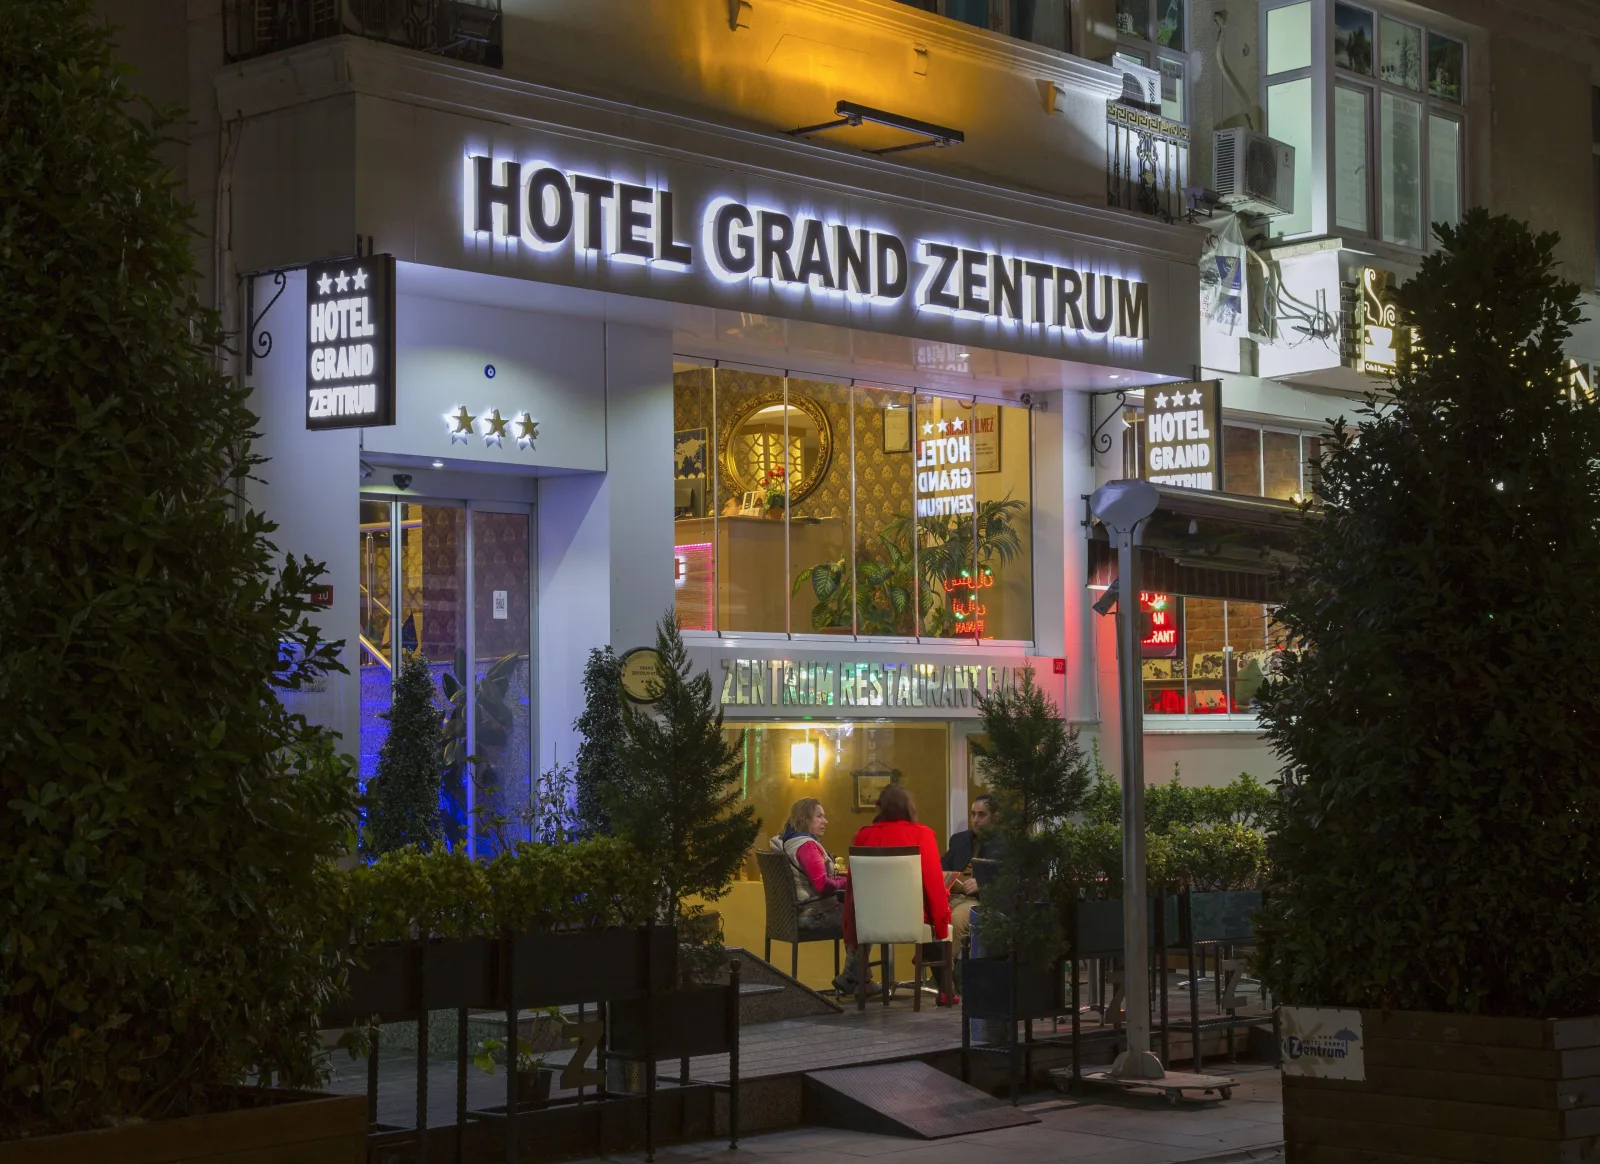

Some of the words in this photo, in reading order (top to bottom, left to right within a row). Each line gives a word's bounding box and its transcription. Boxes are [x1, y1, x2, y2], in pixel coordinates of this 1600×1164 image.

[471, 156, 692, 265] HOTEL
[712, 203, 908, 299] GRAND
[922, 243, 1149, 340] ZENTRUM
[310, 297, 374, 342] HOTEL
[311, 344, 373, 380] GRAND
[309, 384, 376, 417] ZENTRUM
[1149, 410, 1209, 443] HOTEL
[1150, 443, 1210, 470] GRAND
[720, 659, 834, 706] ZENTRUM
[840, 663, 982, 708] RESTAURANT
[1290, 1038, 1345, 1059] Zentrum
